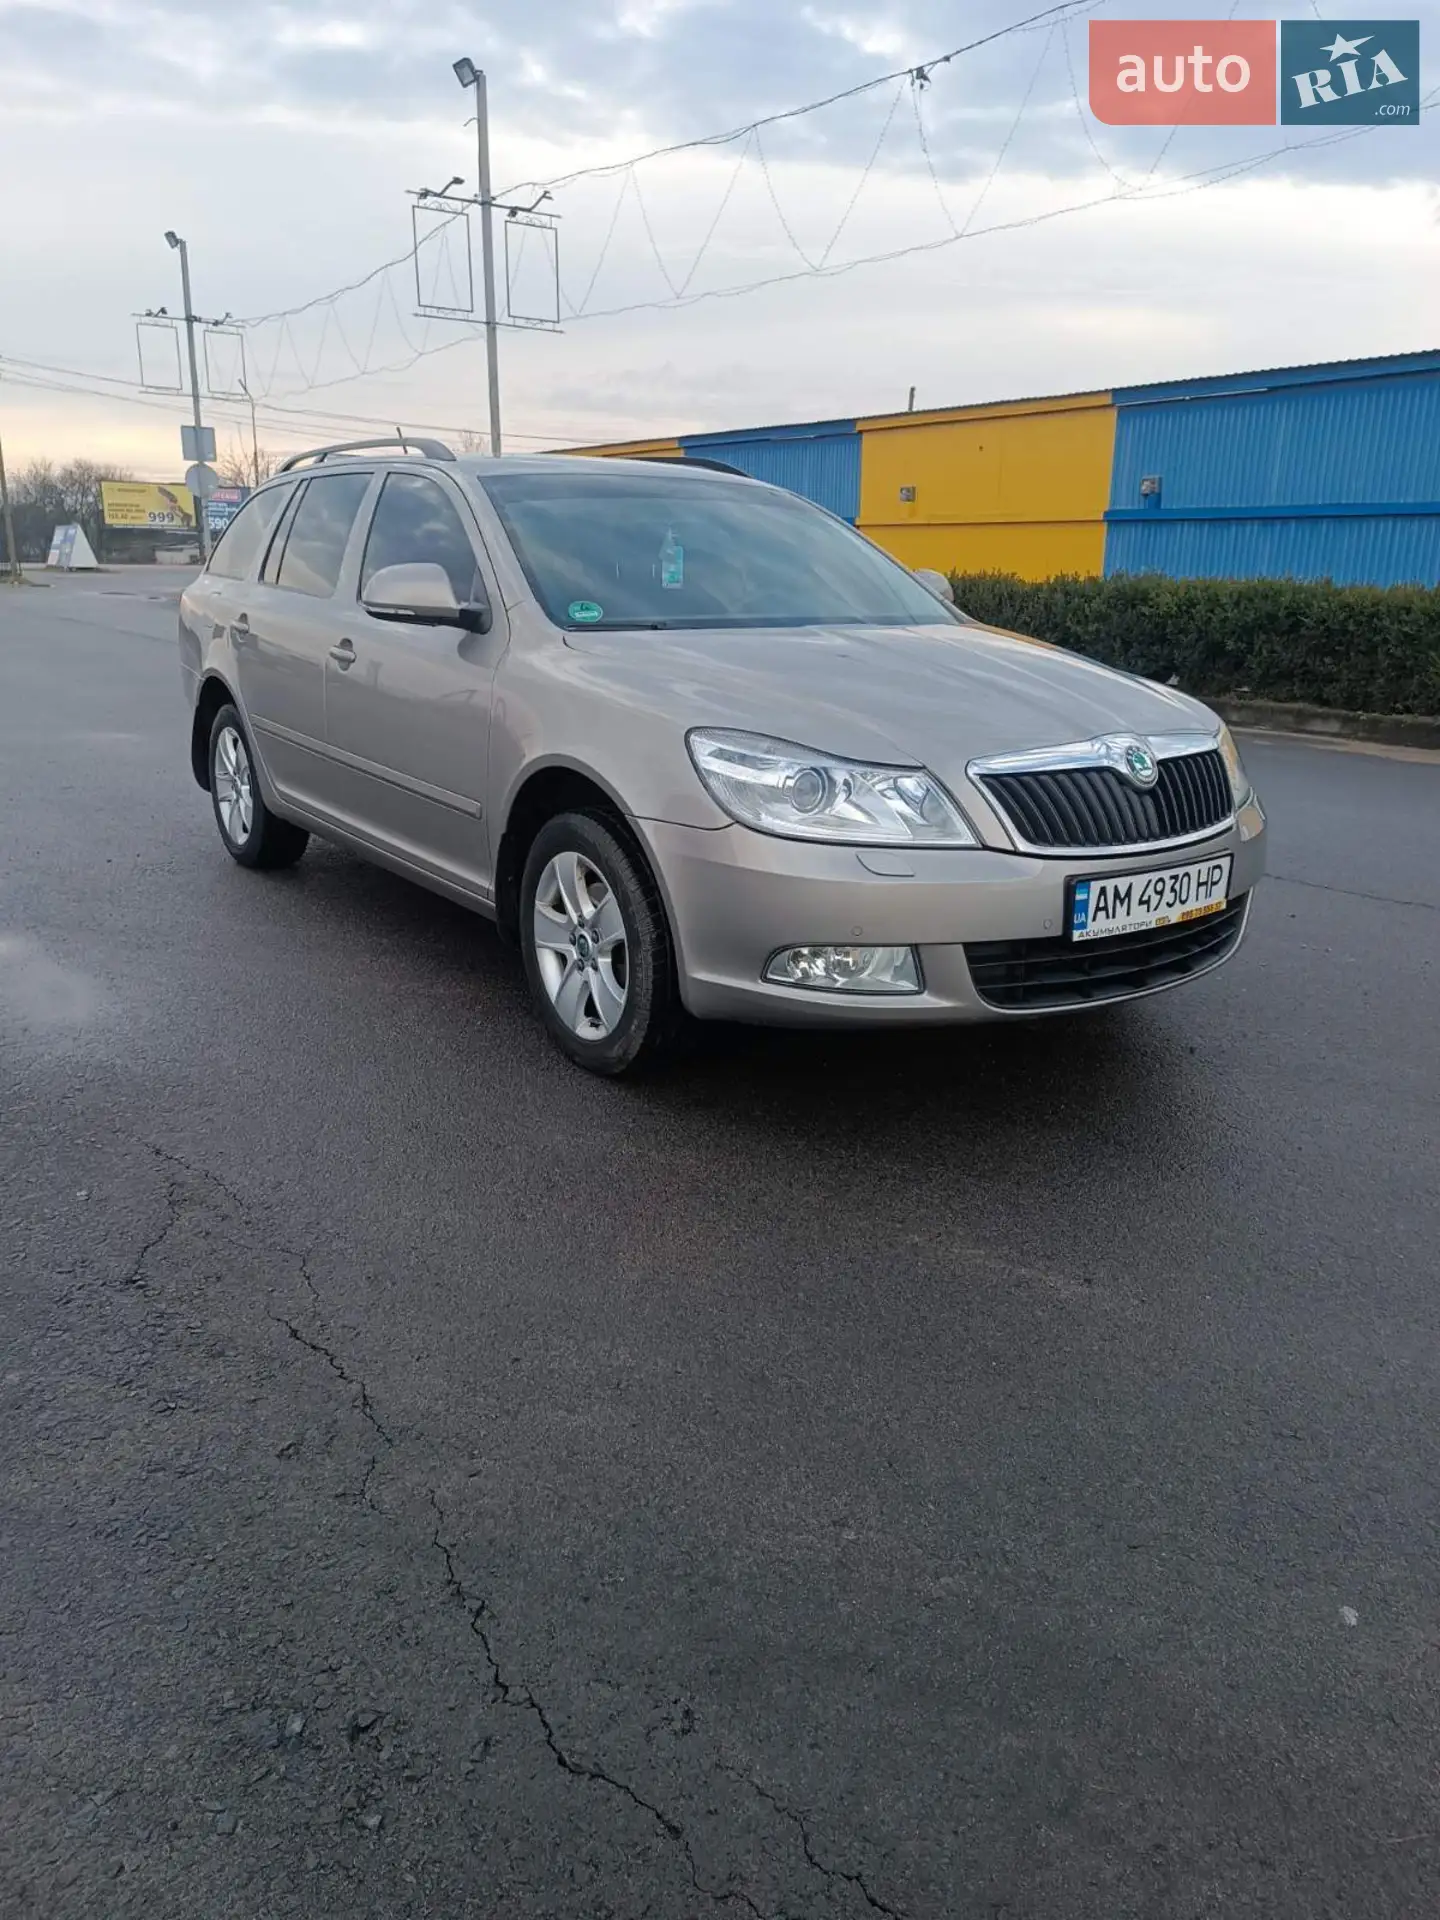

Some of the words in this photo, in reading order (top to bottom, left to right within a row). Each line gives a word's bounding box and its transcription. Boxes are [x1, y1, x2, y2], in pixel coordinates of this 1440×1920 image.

[148, 511, 174, 523] 999
[1092, 882, 1133, 922] AM
[1138, 871, 1191, 913] 4930
[1195, 864, 1224, 902] HP
[1073, 912, 1087, 924] UA
